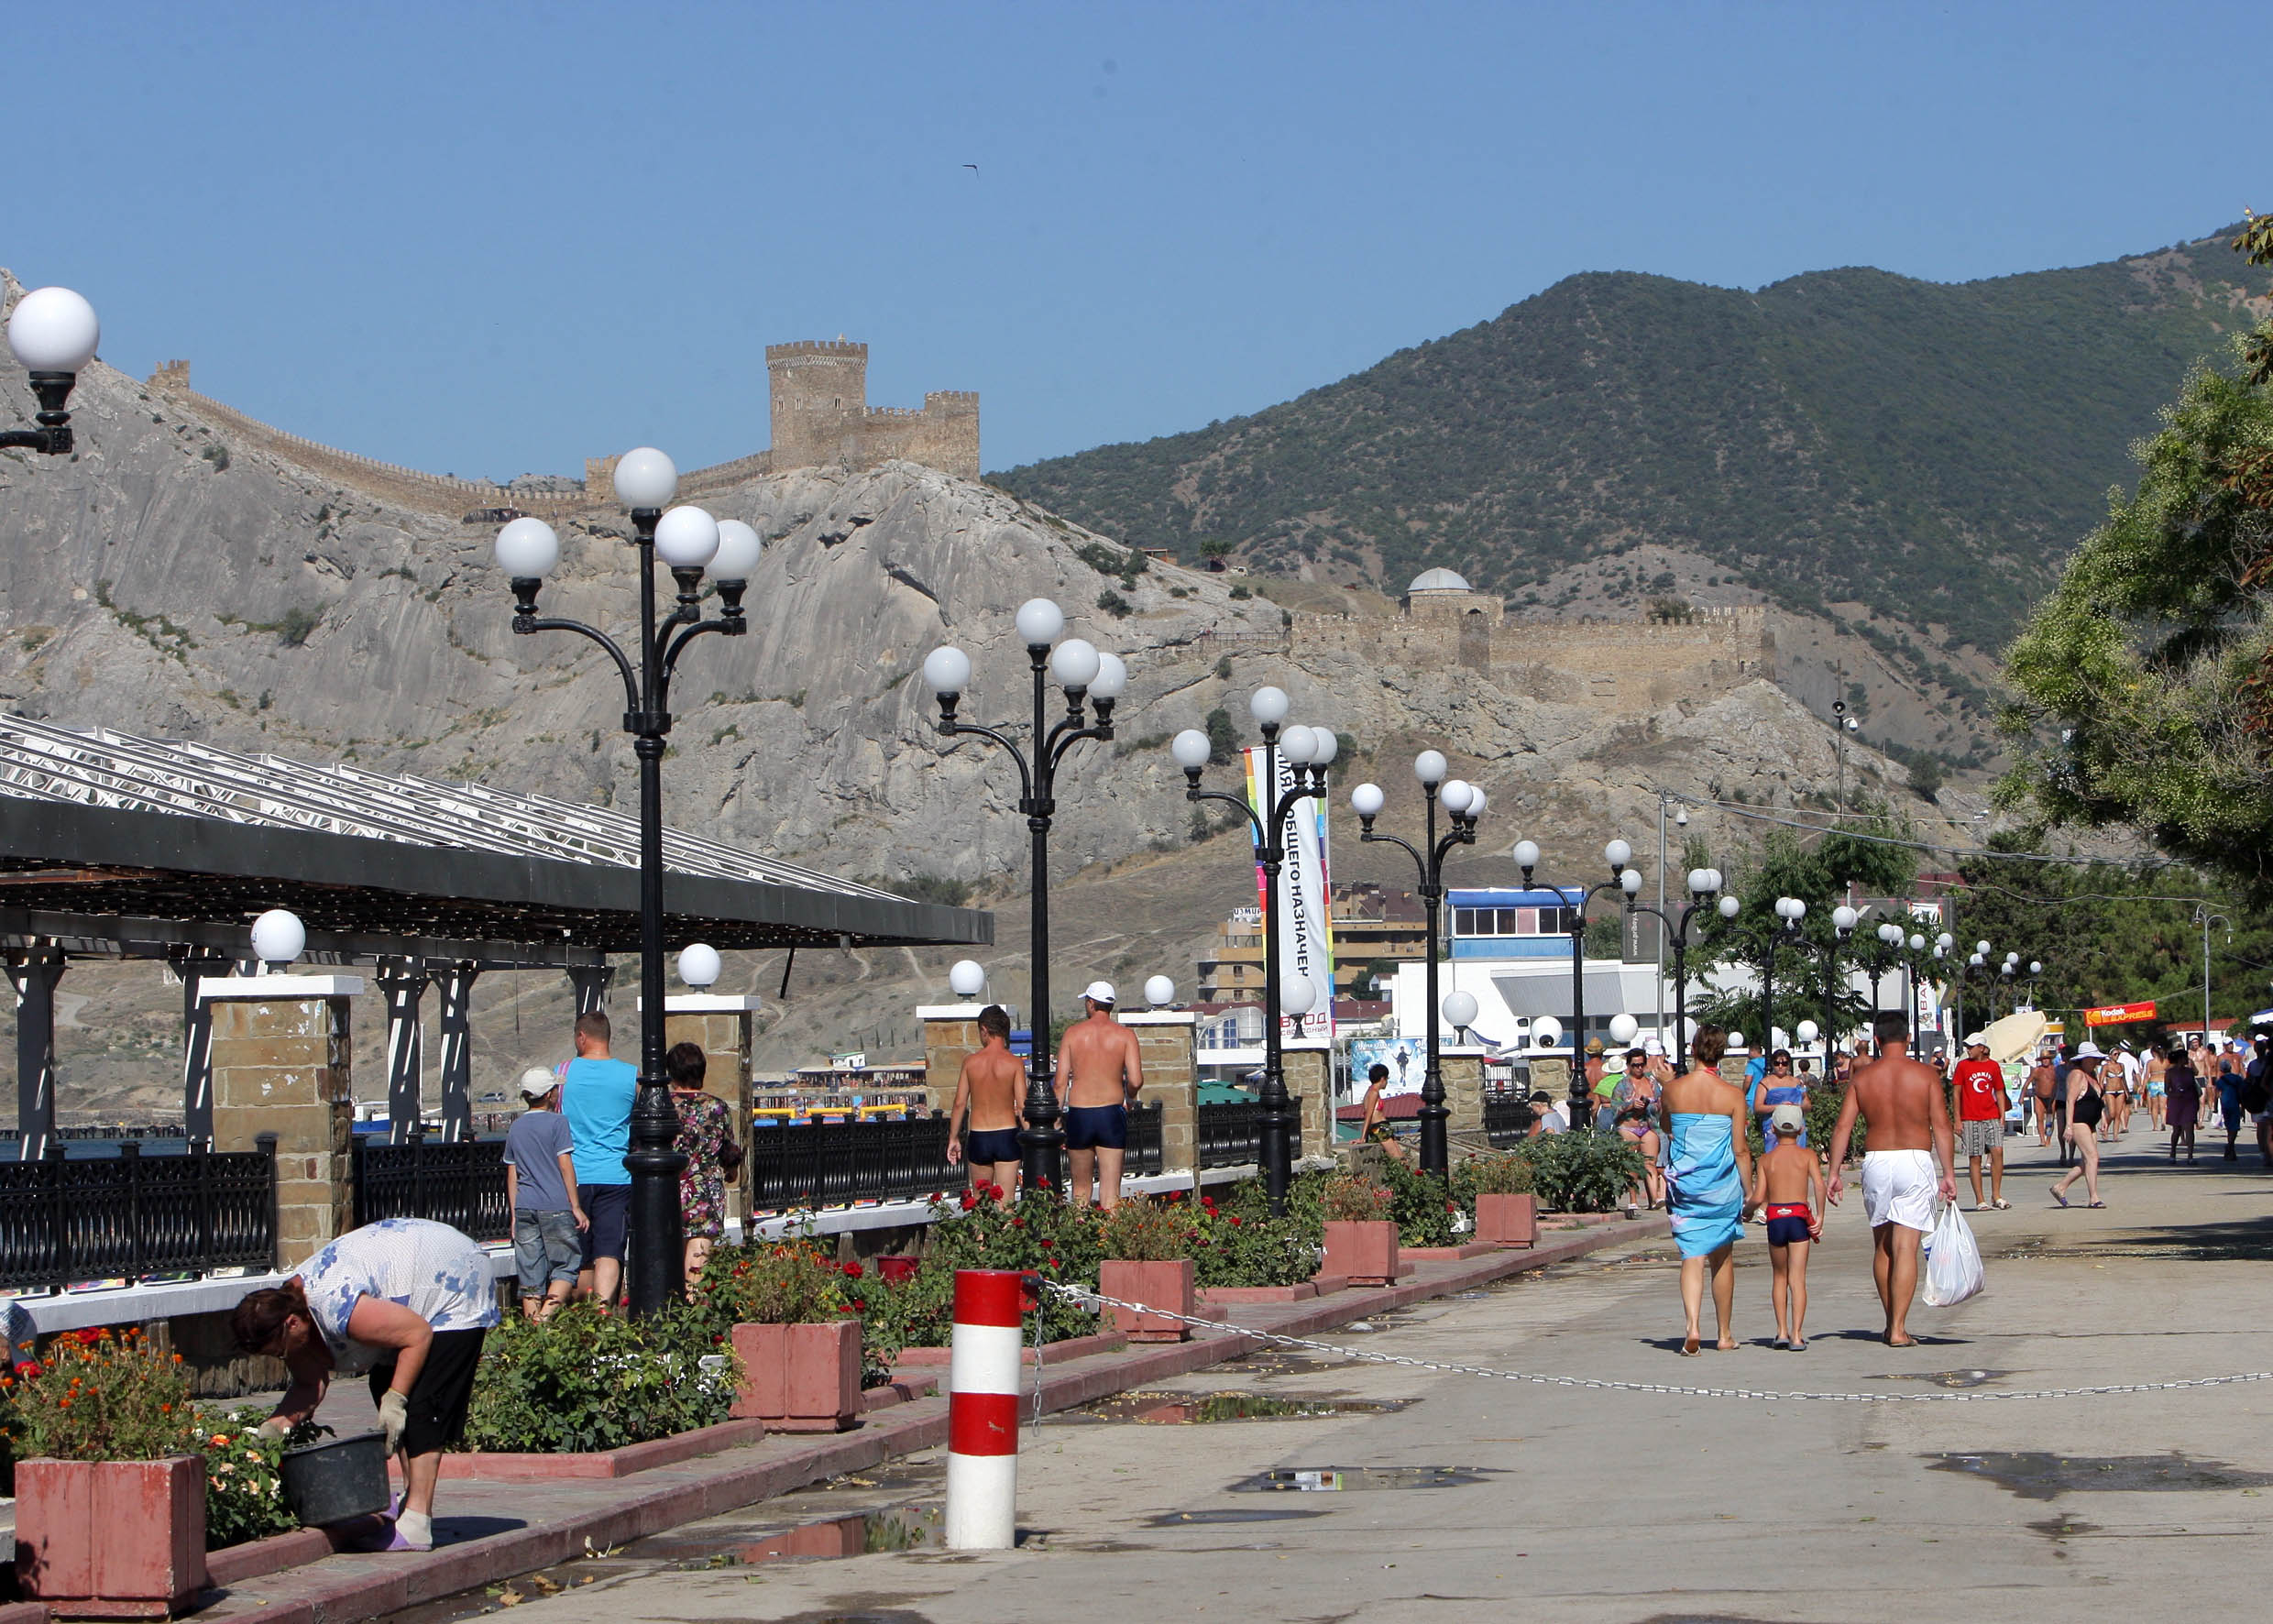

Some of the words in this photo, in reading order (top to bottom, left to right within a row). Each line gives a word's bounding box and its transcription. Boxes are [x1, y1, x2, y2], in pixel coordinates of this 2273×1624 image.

[1278, 753, 1292, 794] ПЛЯ
[1286, 808, 1301, 881] ОБЩЕГО
[1290, 885, 1309, 977] НАЗНАЧЕН
[1279, 1012, 1327, 1027] ВОД
[2101, 1008, 2126, 1017] Kodak
[2107, 1010, 2153, 1022] EXPRESS
[1279, 1026, 1329, 1037] СВООДНЫЙ
